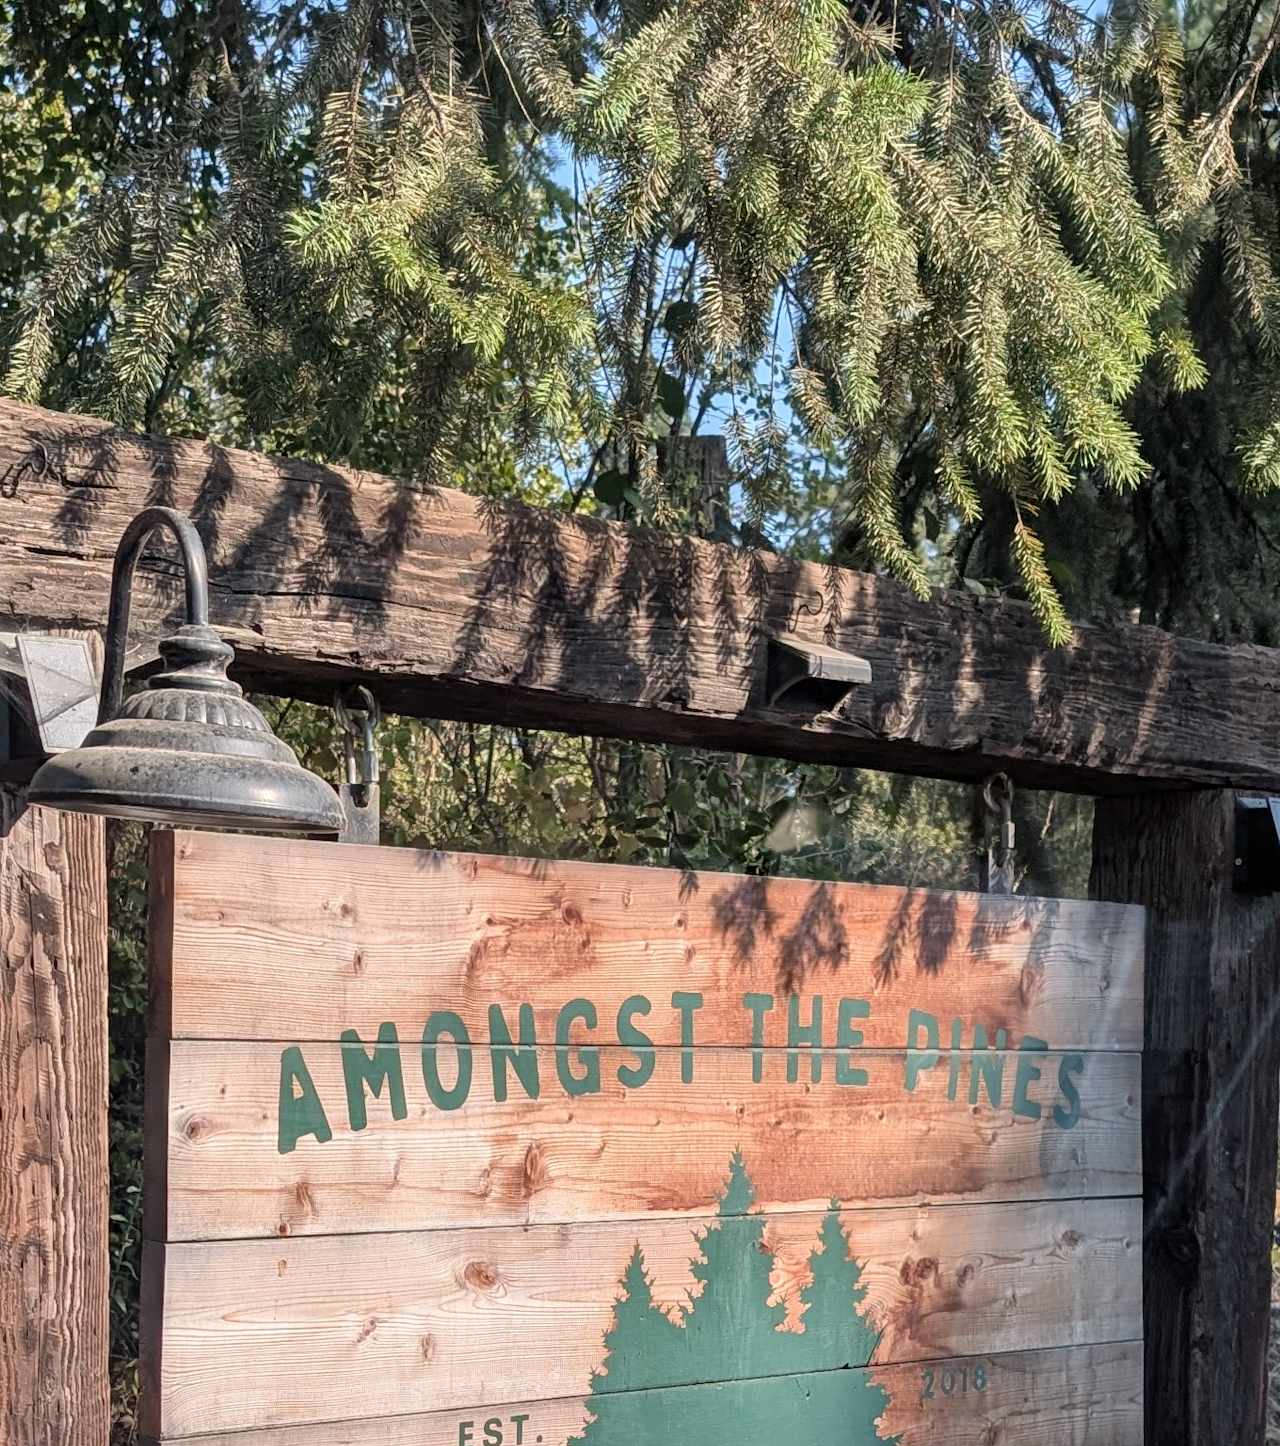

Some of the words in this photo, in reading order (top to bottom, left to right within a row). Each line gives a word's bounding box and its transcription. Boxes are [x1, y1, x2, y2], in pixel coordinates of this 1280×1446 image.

[277, 991, 703, 1155] AMONGST
[742, 992, 871, 1086] THE
[903, 1008, 1083, 1129] PINES
